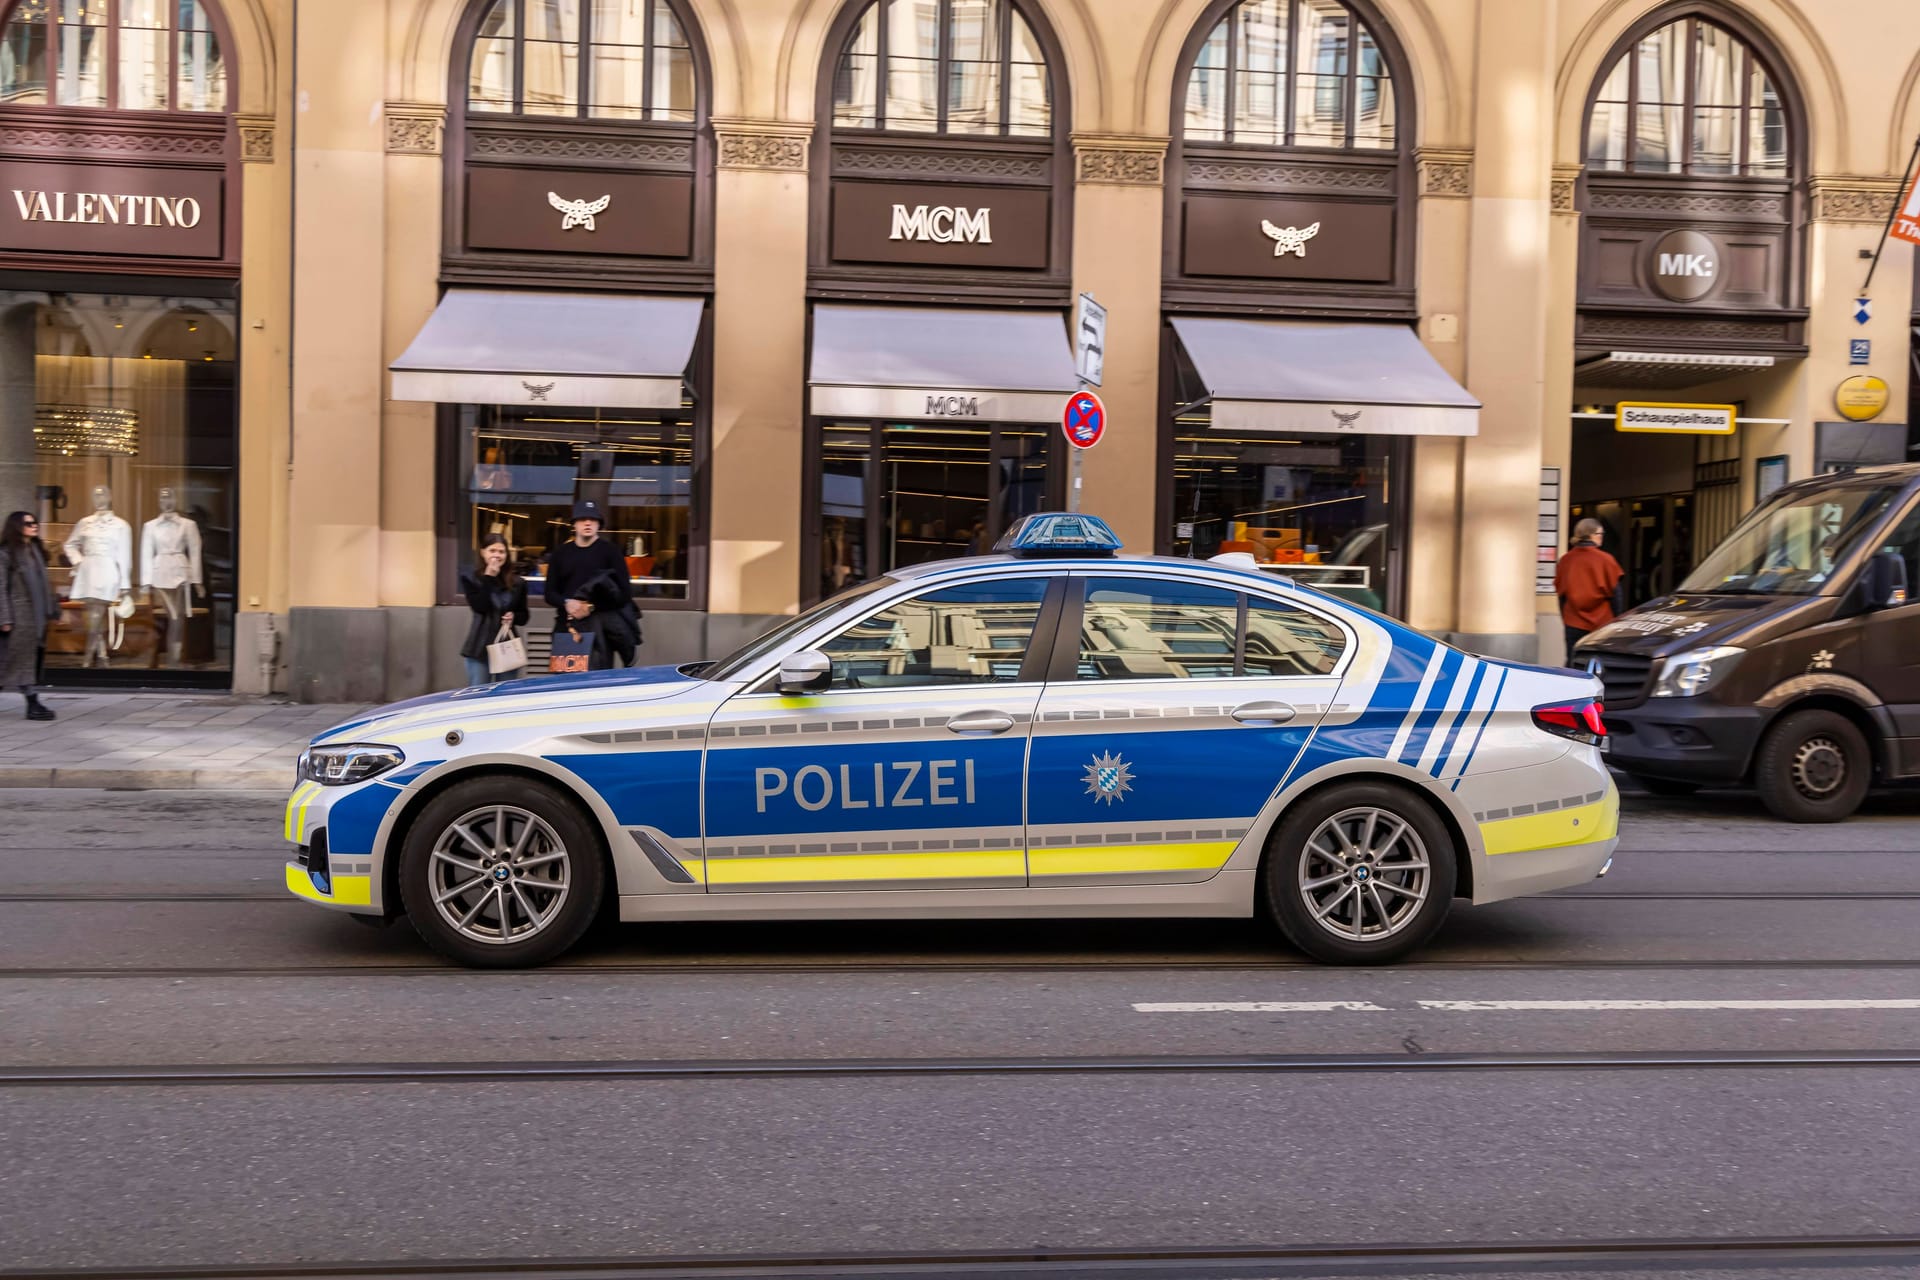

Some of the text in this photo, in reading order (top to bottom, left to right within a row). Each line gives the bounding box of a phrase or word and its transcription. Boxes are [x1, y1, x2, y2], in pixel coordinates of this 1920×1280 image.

[12, 190, 201, 229] VALENTINO
[889, 203, 992, 245] MCM
[1898, 219, 1920, 240] Th
[925, 396, 978, 416] MCM
[1625, 410, 1727, 428] Schauspielhaus
[550, 655, 589, 672] MCM
[755, 758, 976, 814] POLIZEI
